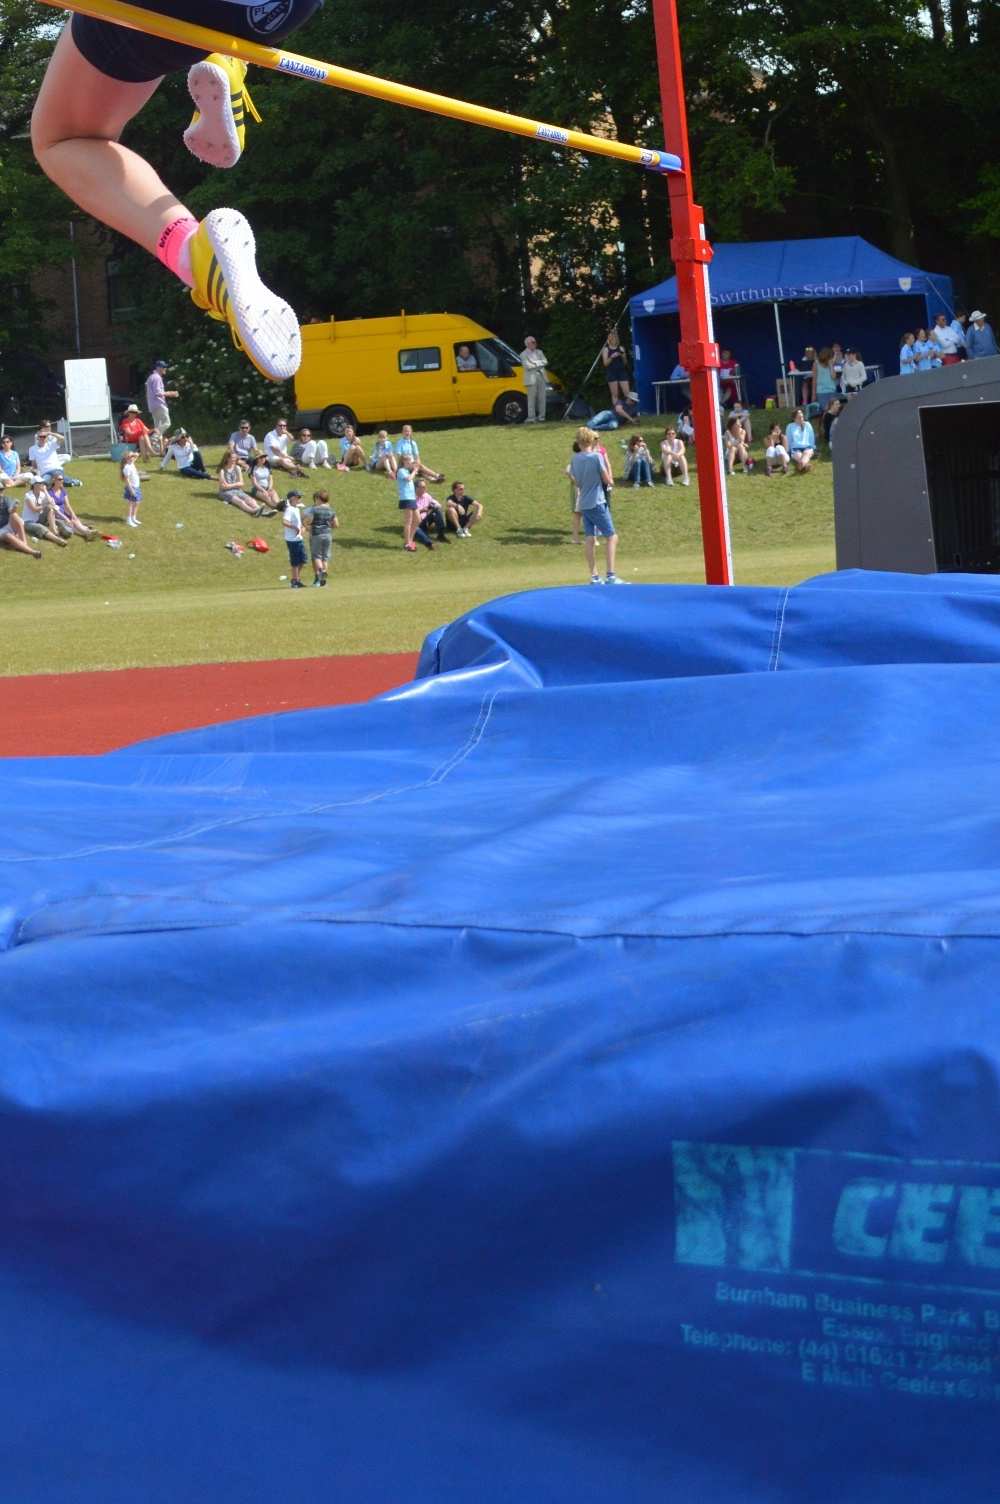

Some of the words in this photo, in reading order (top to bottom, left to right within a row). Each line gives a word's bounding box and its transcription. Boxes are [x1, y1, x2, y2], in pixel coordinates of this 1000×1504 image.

[280, 57, 327, 79] CANTABRIAN
[709, 286, 797, 305] Swithun's
[803, 280, 864, 297] School
[715, 1280, 808, 1310] Burnham
[814, 1292, 914, 1323] Business
[680, 1324, 792, 1355] Telephone:
[799, 1338, 839, 1364] (44)
